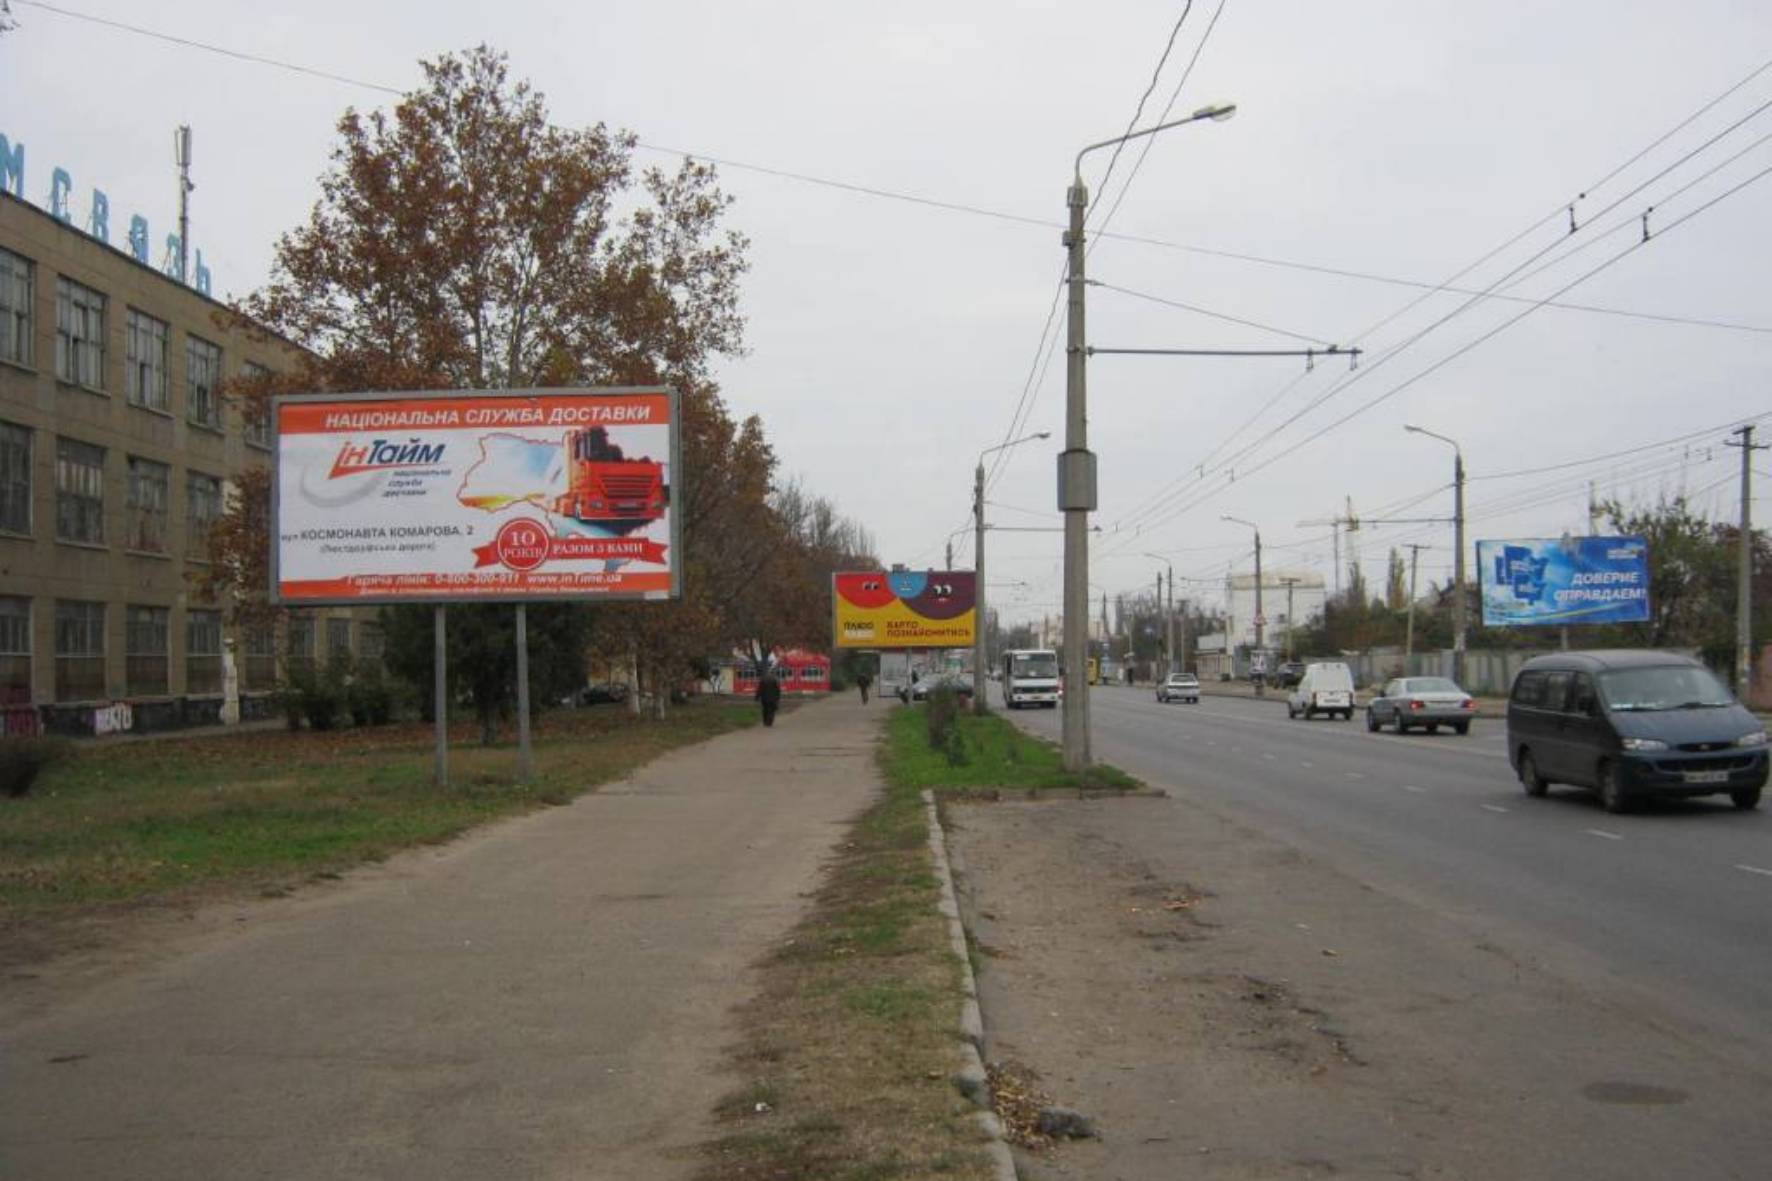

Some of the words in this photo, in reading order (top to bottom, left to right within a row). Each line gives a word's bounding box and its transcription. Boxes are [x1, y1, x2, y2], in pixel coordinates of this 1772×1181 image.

[326, 410, 459, 429] НАЦІОНАЛЬНА
[465, 408, 544, 424] СЛУЖБА
[548, 406, 651, 424] ДОСТАВКИ
[301, 527, 386, 541] КОСМОНАВТА
[467, 525, 475, 536] 2
[510, 531, 536, 546] 10
[504, 548, 543, 559] РОКІВ
[553, 544, 595, 555] РАЗОМ
[608, 543, 643, 554] ВАМИ
[1571, 571, 1641, 586] ДОВЕРИЕ
